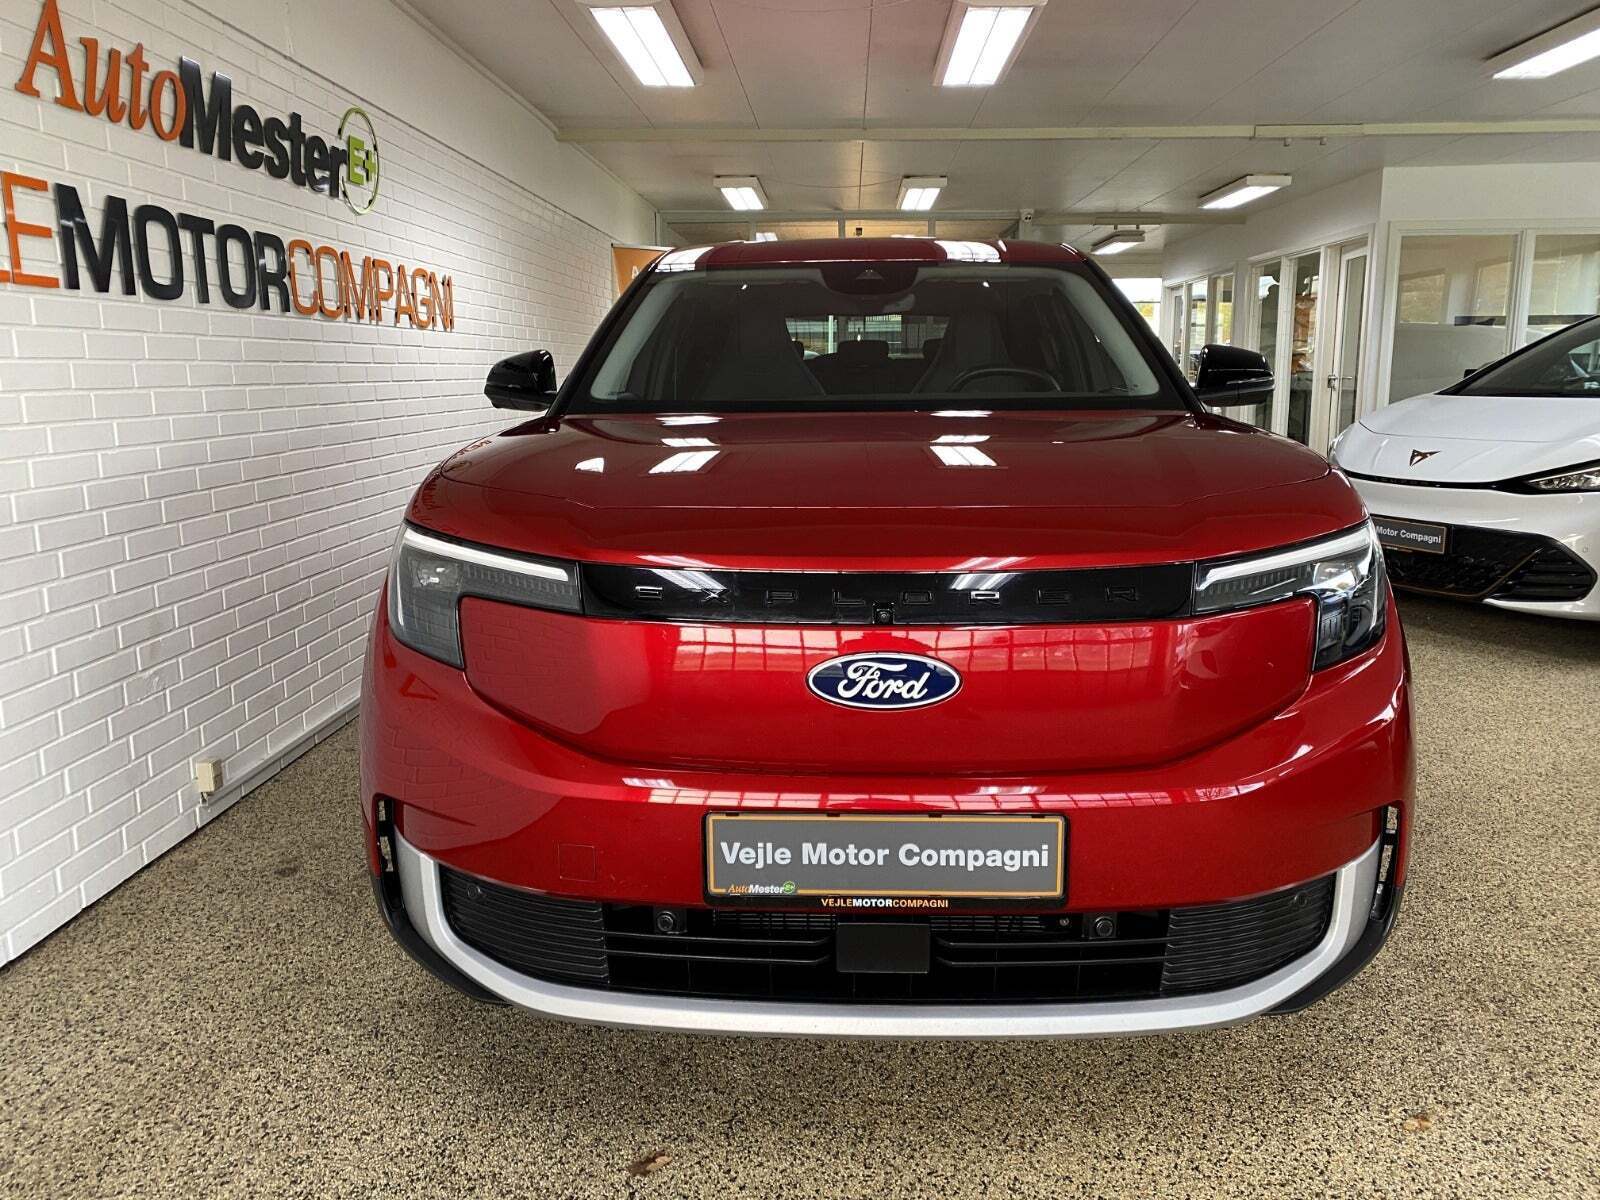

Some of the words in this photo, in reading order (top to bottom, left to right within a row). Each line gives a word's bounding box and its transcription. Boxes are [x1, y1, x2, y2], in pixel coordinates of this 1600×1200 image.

[0, 170, 454, 331] EMOTORCOMPAGNI
[1375, 525, 1398, 537] Motor
[1400, 529, 1441, 544] Compagni
[634, 584, 1138, 606] EXPLORER
[836, 661, 928, 700] Ford
[720, 841, 791, 869] Vejle
[801, 843, 889, 867] Motor
[898, 843, 1049, 871] Compagni
[821, 898, 949, 908] VEJLEMOTORCOMPAGNI
